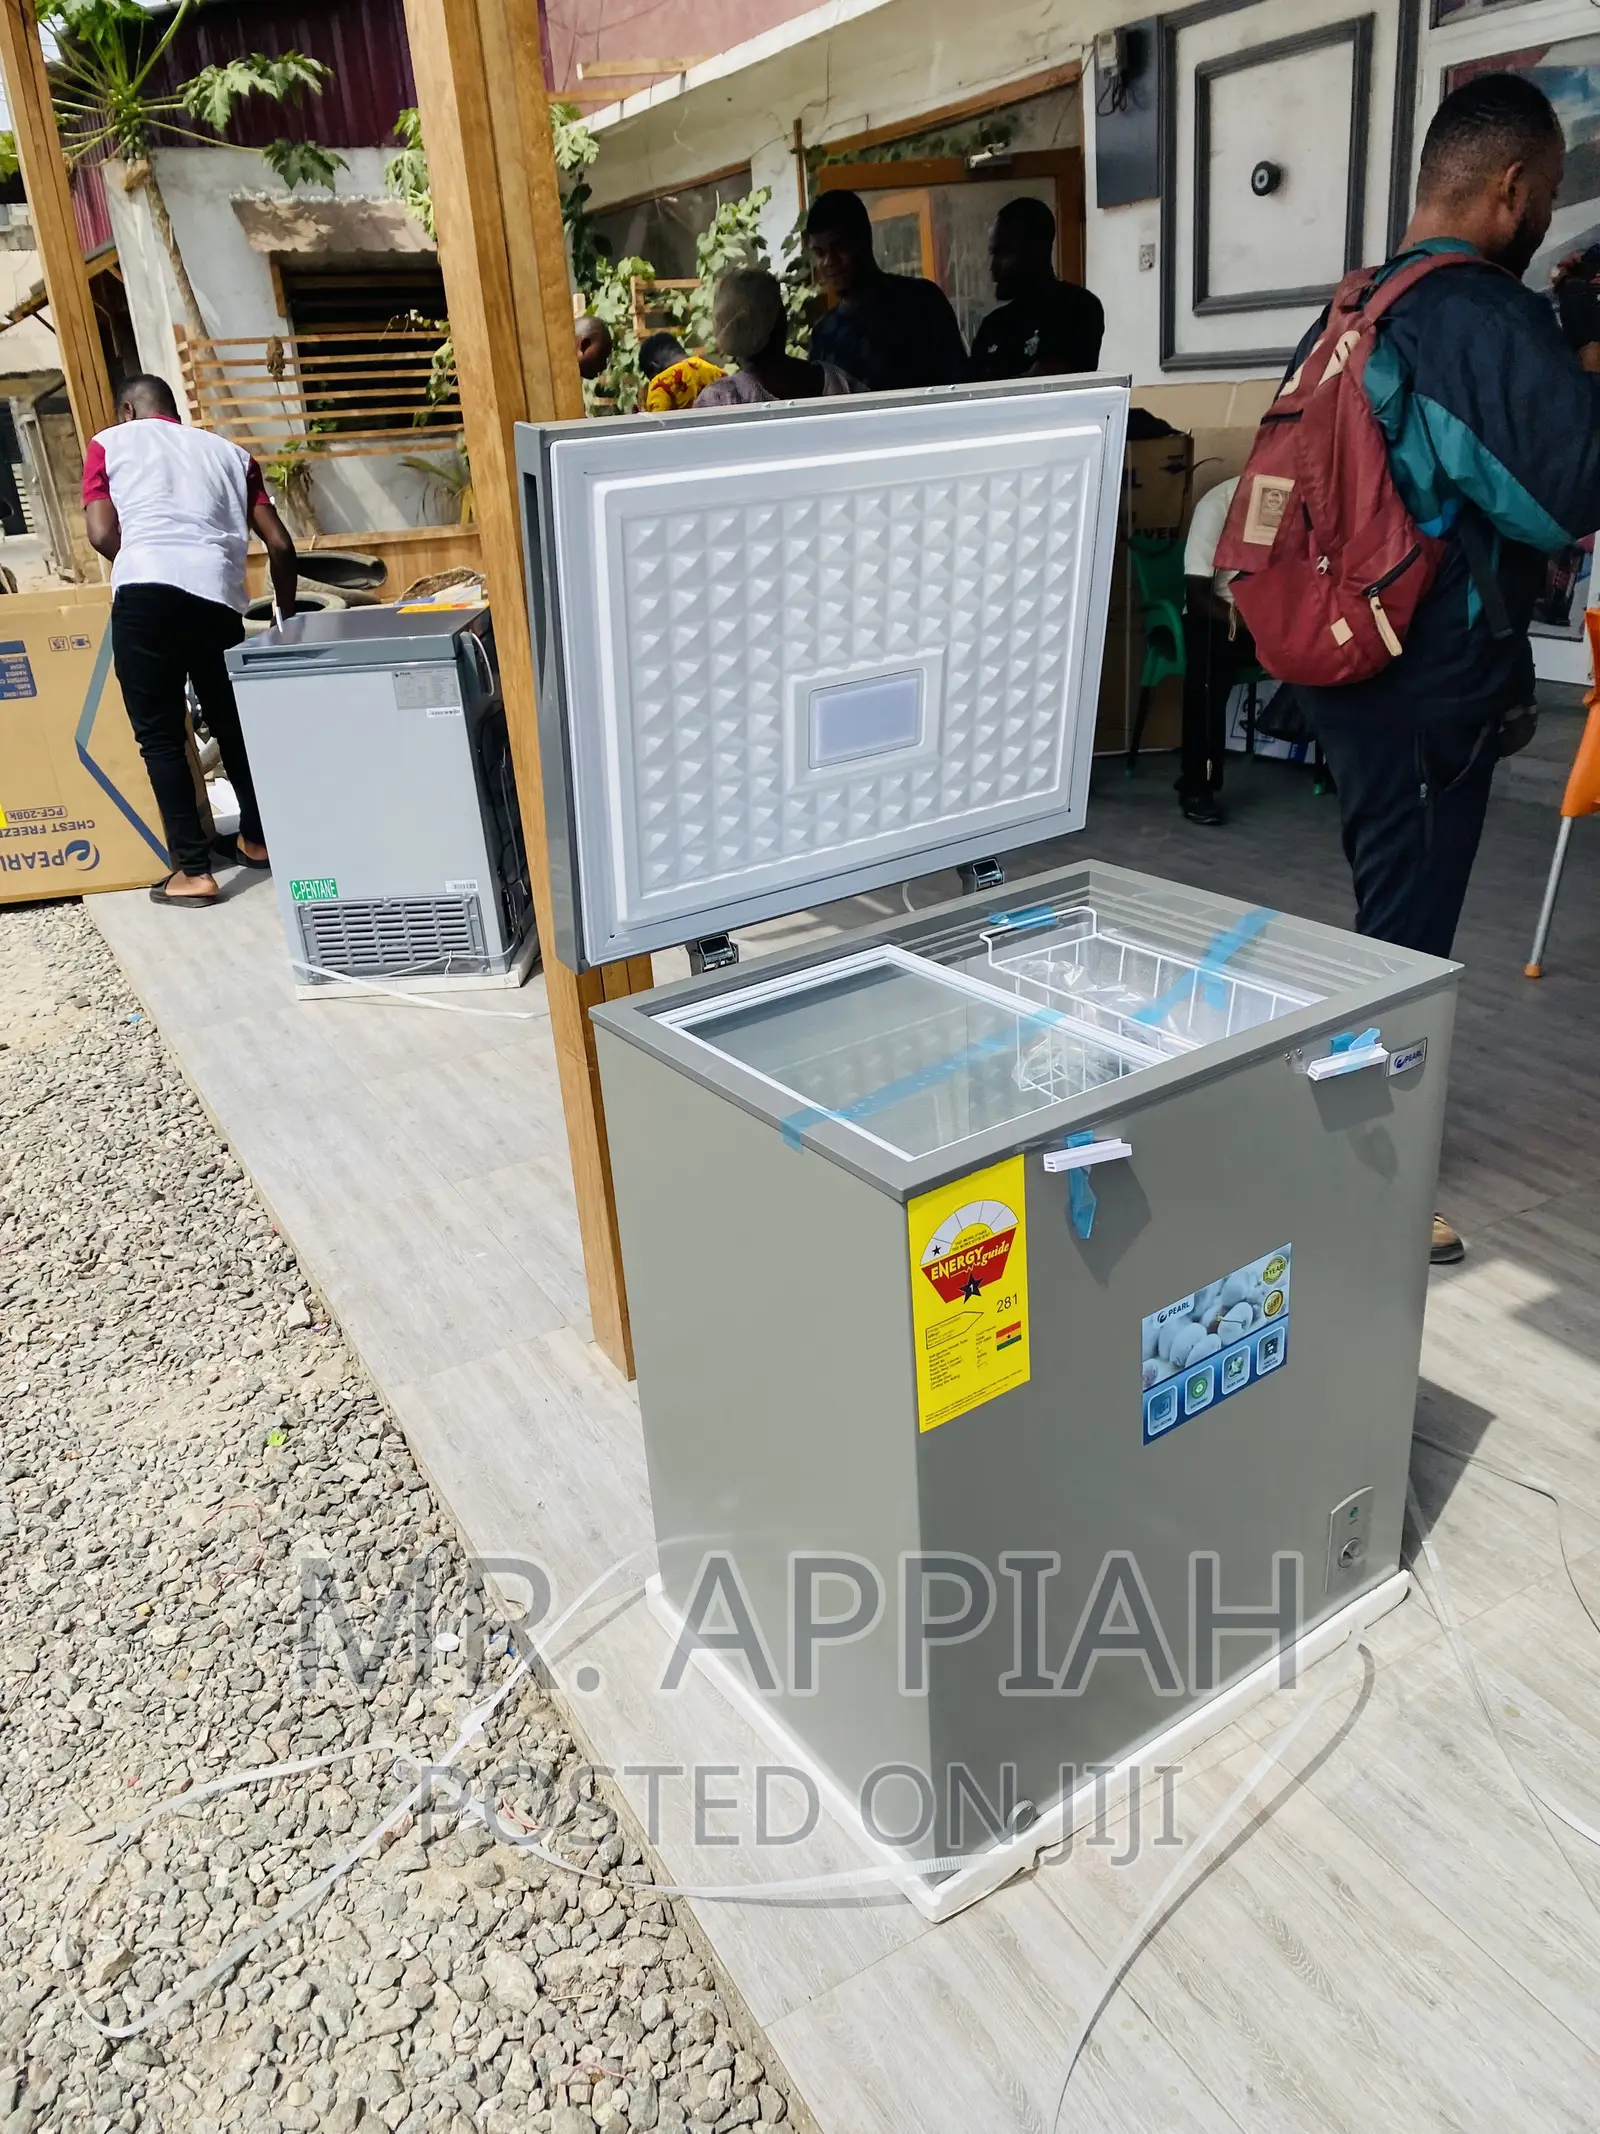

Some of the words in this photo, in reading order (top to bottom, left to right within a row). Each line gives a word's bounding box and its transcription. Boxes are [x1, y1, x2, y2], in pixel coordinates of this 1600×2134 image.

[51, 820, 95, 833] CHEST
[292, 879, 337, 900] C-PENTANE
[1404, 1050, 1423, 1063] PEARL
[930, 1246, 984, 1281] ENERGY
[980, 1240, 1010, 1266] guide
[969, 1284, 974, 1293] 1
[996, 1293, 1019, 1313] 281
[1168, 1300, 1191, 1317] PEARL
